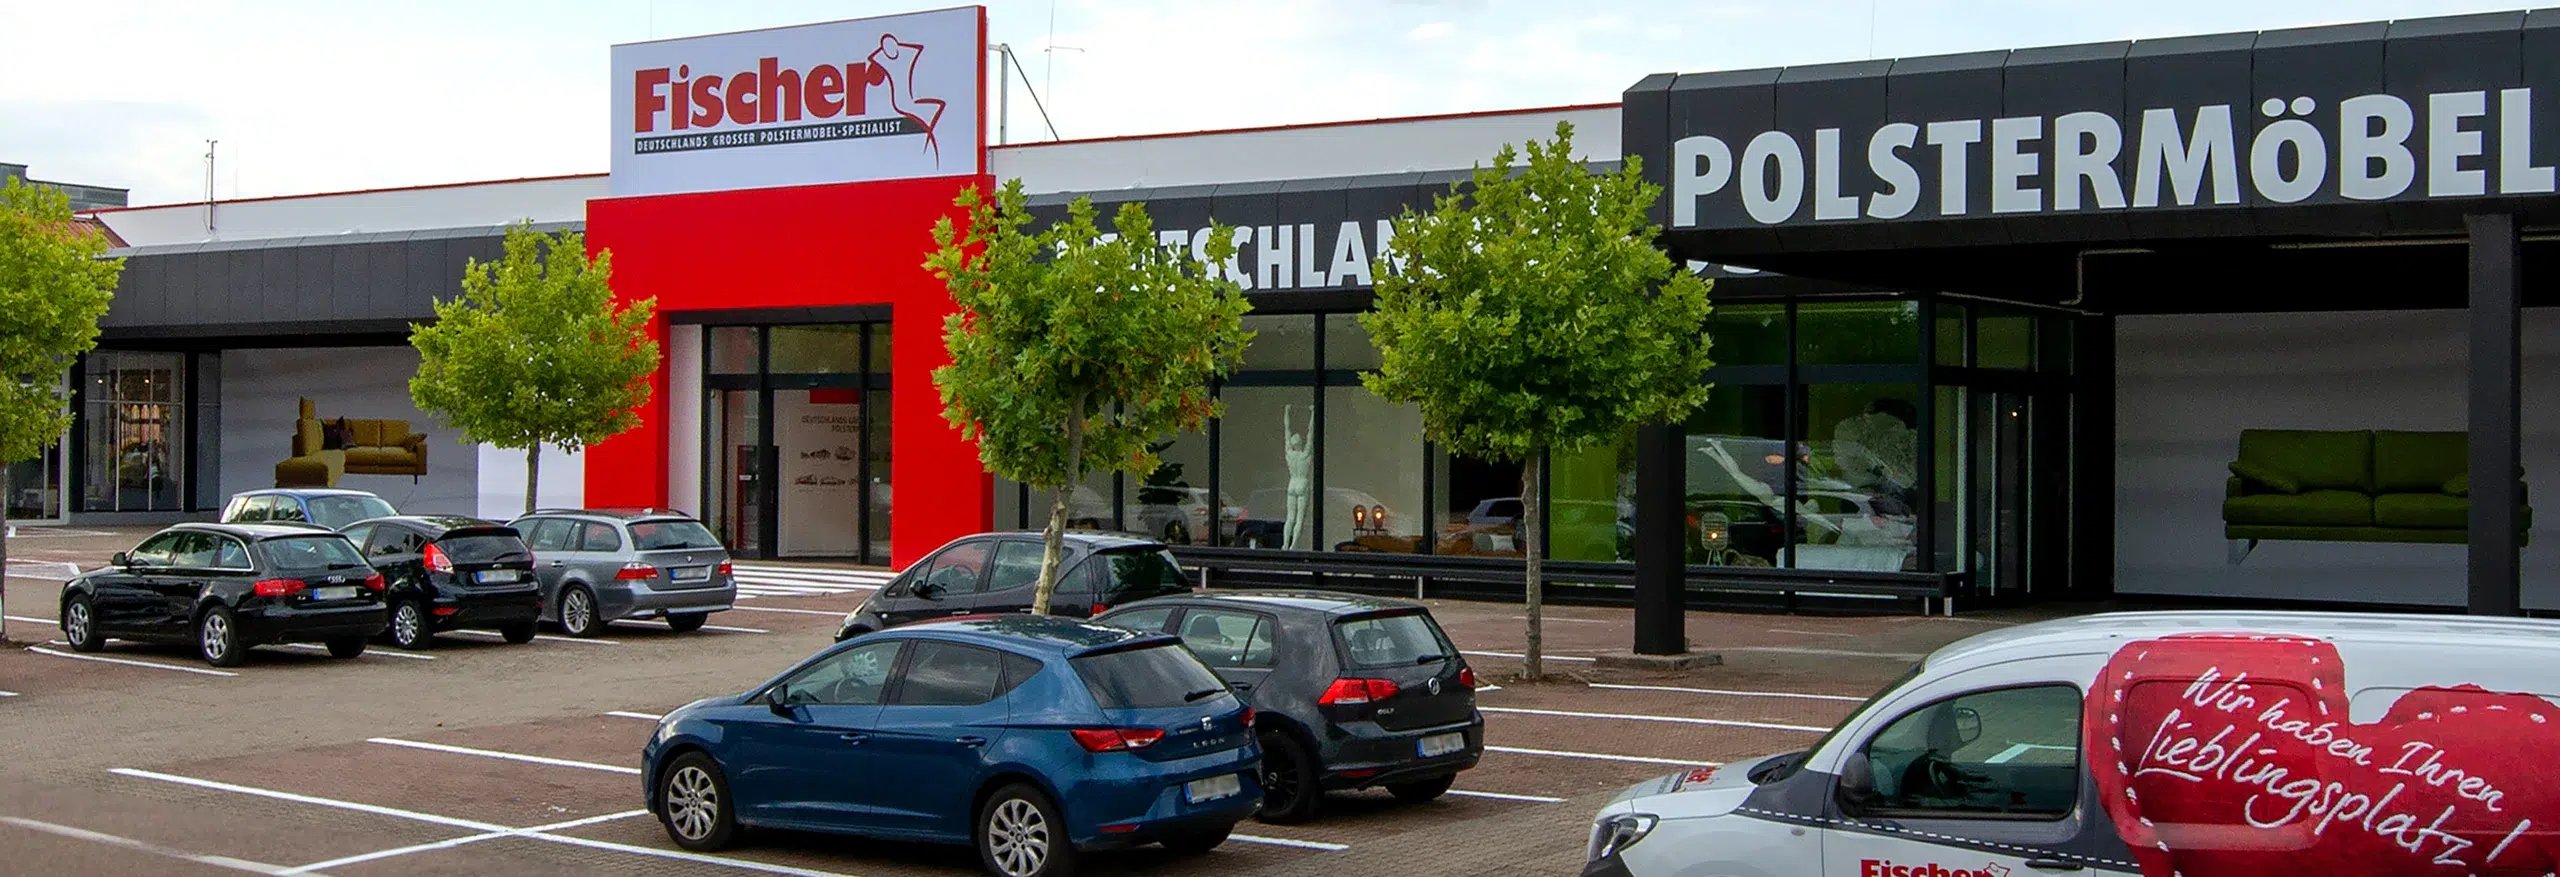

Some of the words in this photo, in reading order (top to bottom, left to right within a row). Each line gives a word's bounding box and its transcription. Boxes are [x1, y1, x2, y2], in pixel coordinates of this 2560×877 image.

[635, 57, 886, 133] Fischer
[637, 137, 707, 152] DEUTSCHLANDS
[712, 134, 755, 147] GROSSER
[760, 121, 901, 142] POLSTERMÖBEL-SPEZIALIST
[1674, 87, 2555, 227] POLSTERMÖBEL
[2183, 667, 2255, 713] Wir
[2257, 698, 2375, 766] haben
[2379, 740, 2505, 812] Ihren
